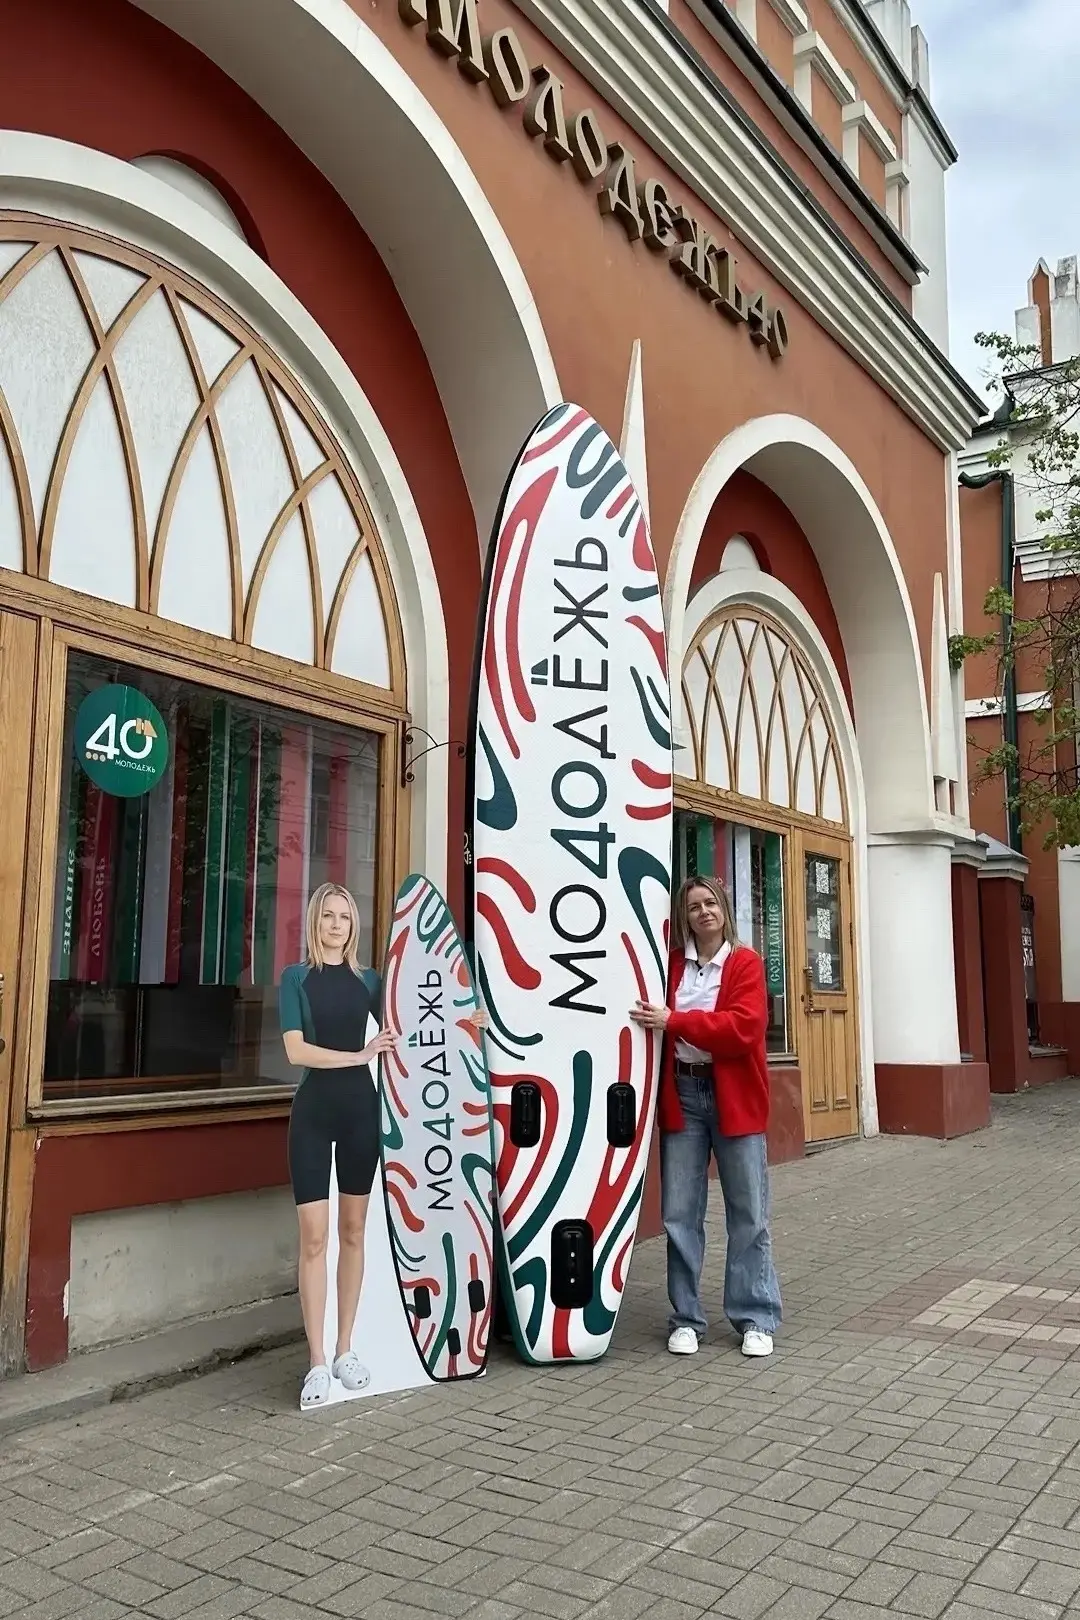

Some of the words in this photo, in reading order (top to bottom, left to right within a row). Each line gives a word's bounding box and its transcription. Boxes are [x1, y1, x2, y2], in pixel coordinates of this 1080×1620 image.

[747, 290, 789, 360] 40
[85, 713, 156, 760] 40
[114, 759, 156, 774] МОЛОДЕЖЬ
[63, 848, 75, 956] ЗНАНИЕ
[91, 856, 106, 957] ЛЮБОВЬ
